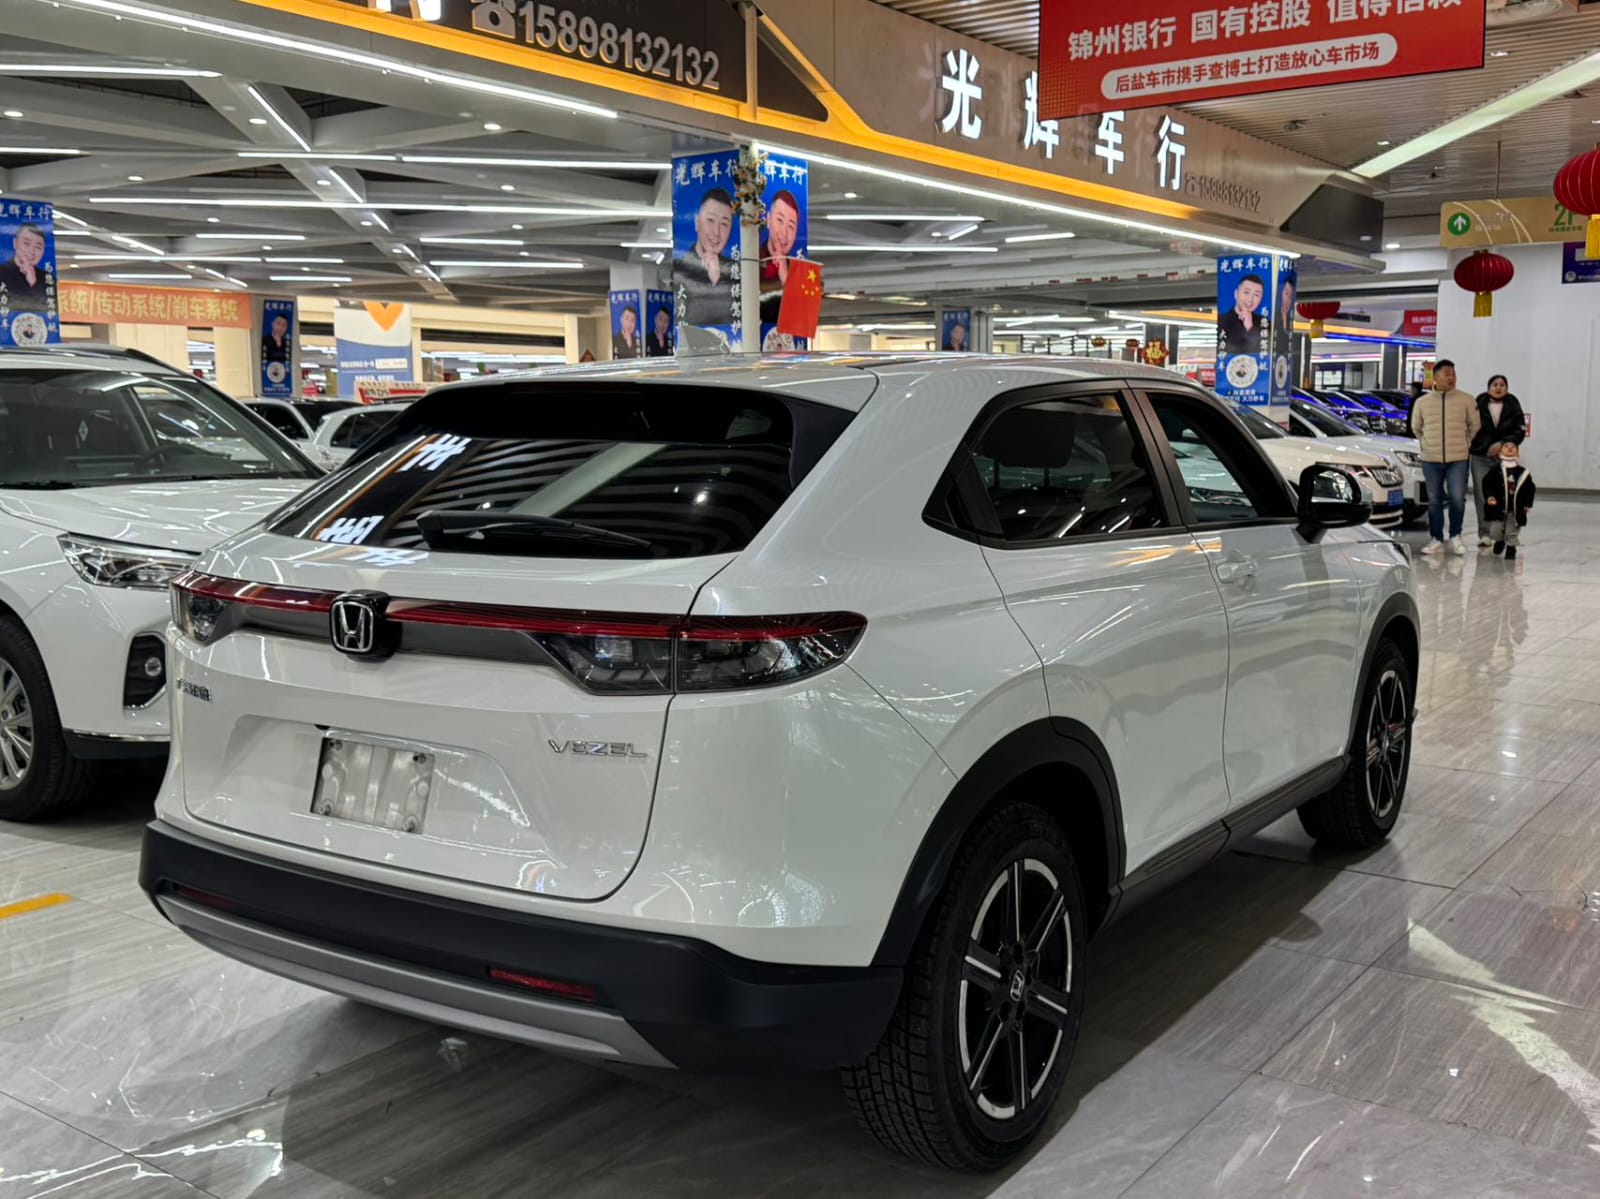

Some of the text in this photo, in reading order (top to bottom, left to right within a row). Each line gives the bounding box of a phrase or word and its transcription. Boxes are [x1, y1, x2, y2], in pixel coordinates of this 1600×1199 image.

[518, 0, 721, 90] 15898132132
[1068, 16, 1177, 61] 锦州银行
[1191, 0, 1312, 43] 国有控股
[1114, 40, 1380, 93] 后盐车市携手查博士打造放心车市场
[1199, 175, 1262, 213] 15898132132
[548, 739, 648, 758] VEZEL
